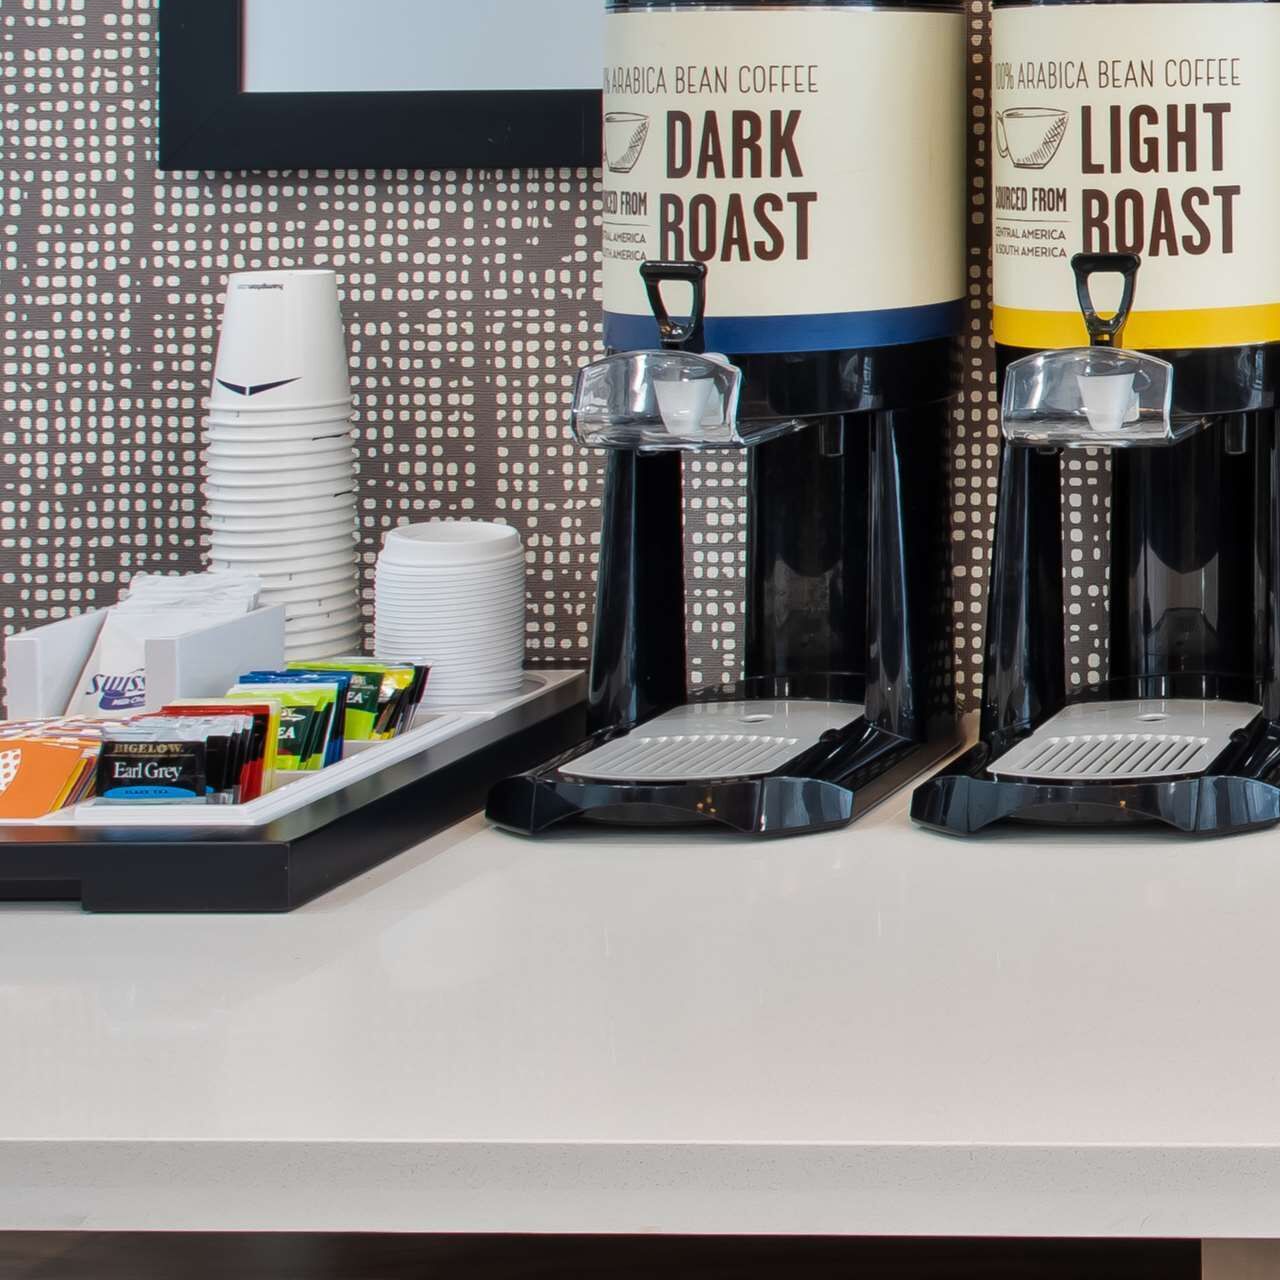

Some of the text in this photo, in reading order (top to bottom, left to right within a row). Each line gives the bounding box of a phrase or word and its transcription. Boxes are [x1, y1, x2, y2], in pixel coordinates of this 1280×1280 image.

[611, 66, 668, 94] ARABICA
[674, 65, 728, 94] BEAN
[738, 65, 819, 94] COFFEE
[1017, 60, 1089, 89] ARABICA
[1098, 59, 1154, 88] BEAN
[1165, 58, 1242, 87] COFFEE
[666, 109, 804, 180] DARK
[1081, 102, 1232, 175] LIGHT
[1031, 187, 1067, 212] FROM
[660, 191, 818, 262] ROAST
[1021, 228, 1067, 241] AMERICA
[1081, 184, 1242, 258] ROAST
[1021, 246, 1068, 258] AMERICA
[113, 761, 183, 782] Earl Grey
